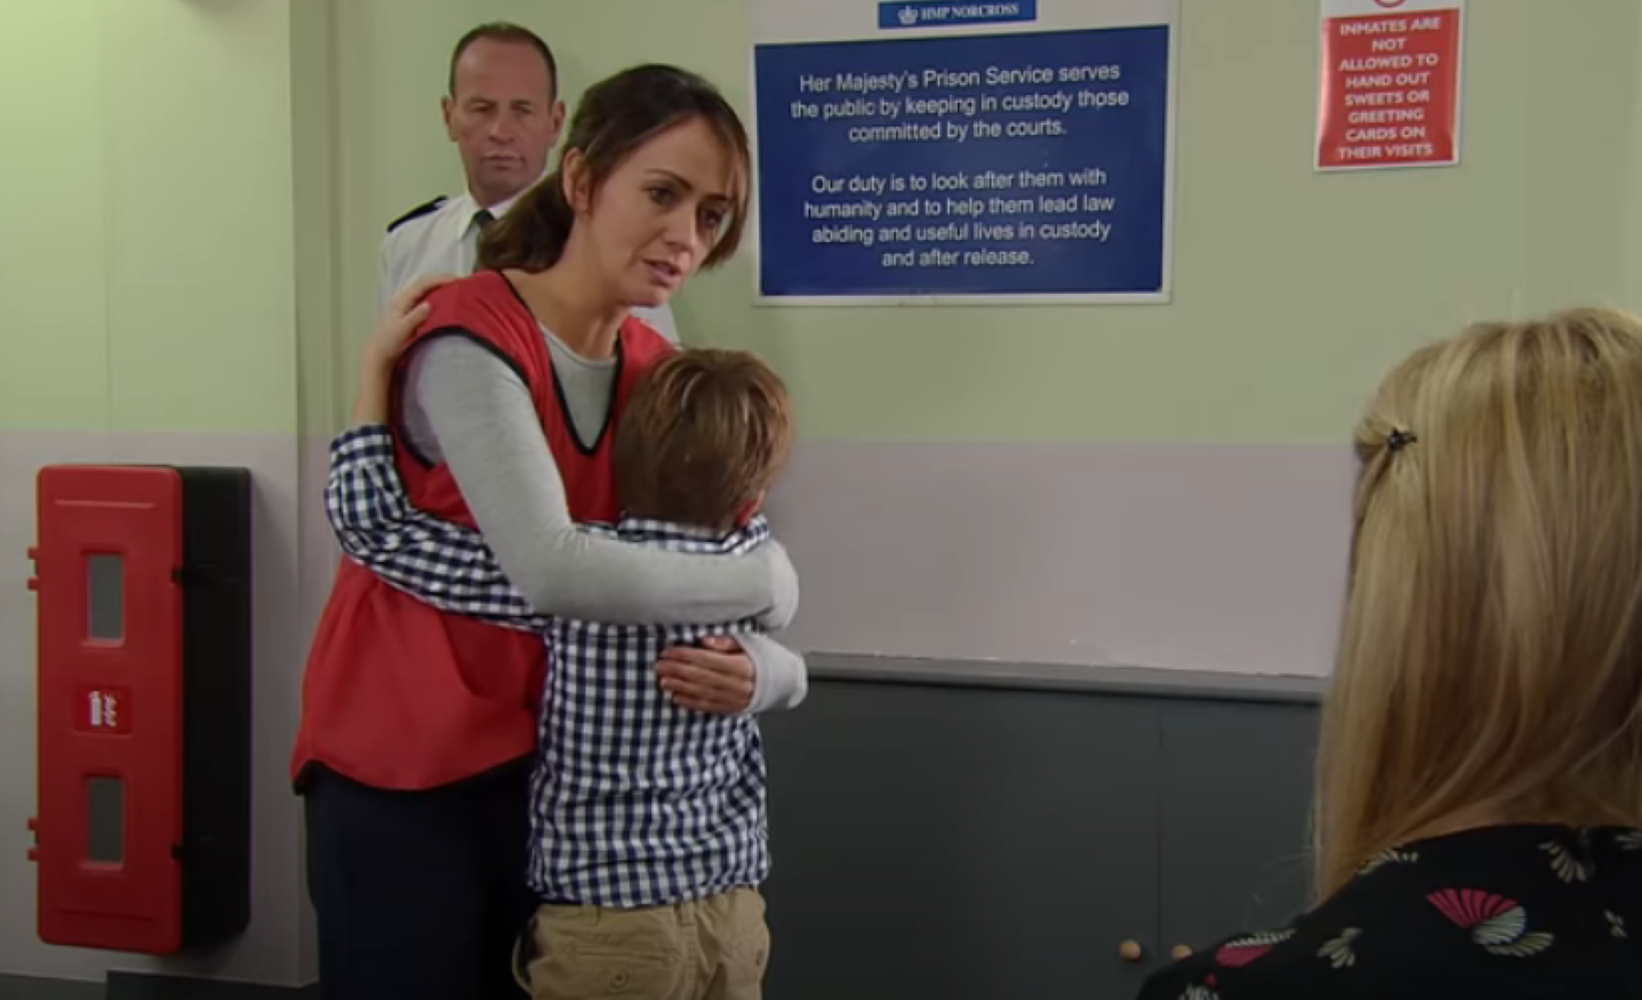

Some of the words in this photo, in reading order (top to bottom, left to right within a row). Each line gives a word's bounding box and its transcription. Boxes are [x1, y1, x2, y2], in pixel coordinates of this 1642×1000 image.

[1340, 20, 1407, 35] INMATES
[1410, 17, 1441, 30] ARE
[1372, 38, 1407, 51] NOT
[1339, 55, 1412, 71] ALLOWED
[1417, 53, 1439, 66] TO
[800, 74, 831, 93] Her
[836, 69, 919, 92] Majesty's
[923, 69, 980, 88] Prison
[985, 66, 1053, 85] Service
[1058, 65, 1120, 82] serves
[1345, 75, 1392, 88] HAND
[1396, 72, 1429, 85] OUT
[791, 101, 819, 119] the
[823, 98, 875, 121] public
[879, 98, 901, 119] by
[905, 95, 975, 117] keeping
[981, 94, 998, 111] in
[1002, 92, 1072, 113] custody
[1078, 89, 1129, 107] those
[1345, 92, 1403, 106] SWEETS
[1407, 90, 1430, 102] OR
[1348, 108, 1424, 123] GREETING
[849, 124, 941, 142] committed
[947, 122, 969, 142] by
[973, 121, 1001, 138] the
[1006, 120, 1067, 137] courts.
[1345, 128, 1397, 141] CARDS
[1400, 126, 1425, 138] ON
[1338, 146, 1381, 159] THEIR
[1385, 143, 1433, 157] VISITS
[811, 176, 844, 193] Our
[849, 174, 886, 196] duty
[890, 174, 906, 191] is
[910, 175, 927, 191] to
[932, 173, 969, 190] look
[973, 171, 1014, 188] after
[1018, 169, 1064, 188] them
[1068, 168, 1107, 186] with
[804, 201, 882, 220] humanity
[887, 199, 919, 217] and
[924, 199, 941, 216] to
[946, 199, 984, 219] help
[988, 197, 1034, 214] them
[1038, 195, 1078, 213] lead
[1082, 195, 1115, 212] law
[812, 225, 873, 246] abiding
[878, 224, 911, 242] and
[916, 224, 969, 241] useful
[973, 223, 1014, 239] lives
[1018, 222, 1035, 238] in
[1040, 220, 1112, 241] custody
[882, 249, 915, 266] and
[919, 248, 959, 265] after
[964, 247, 1033, 265] release.
